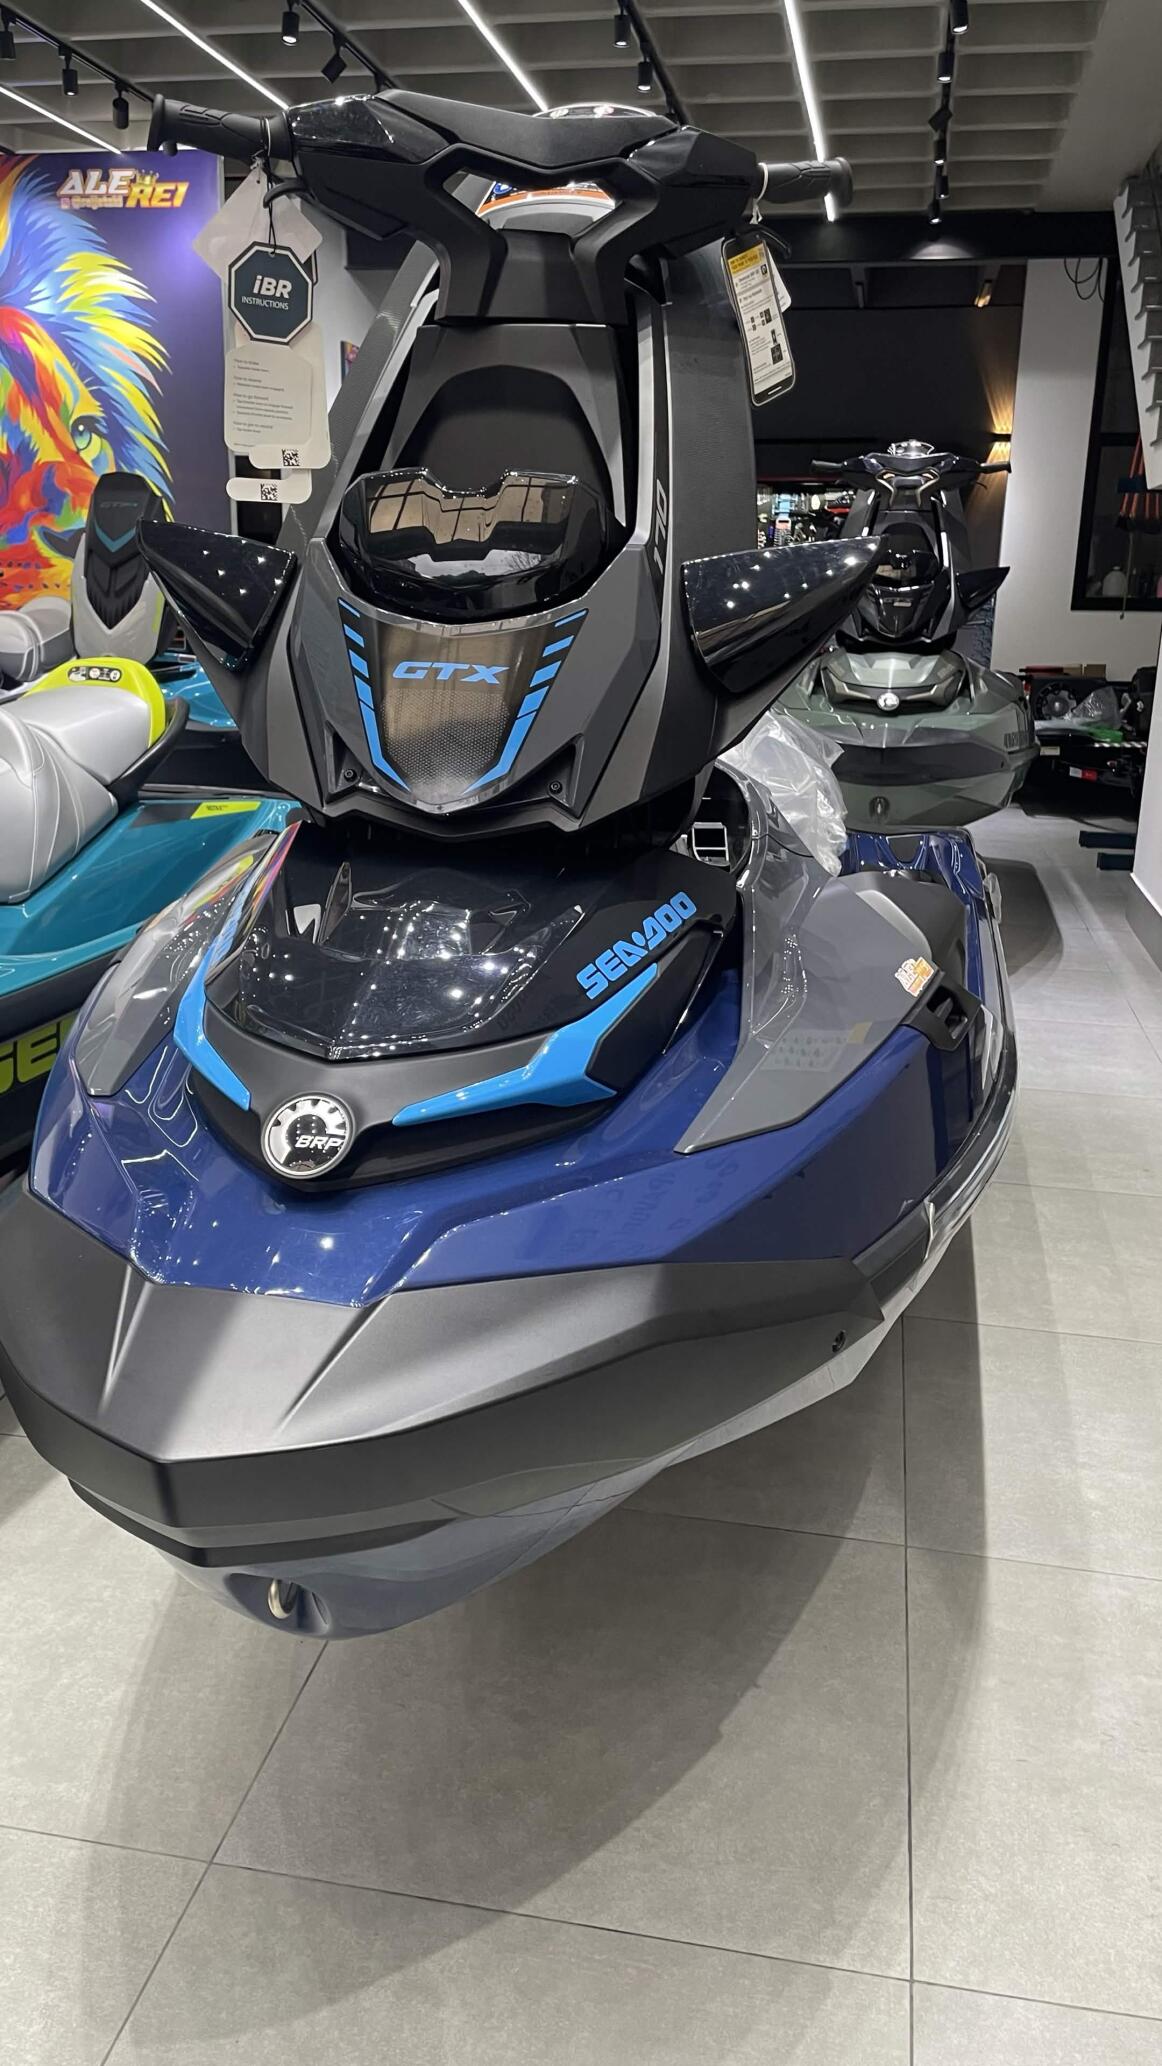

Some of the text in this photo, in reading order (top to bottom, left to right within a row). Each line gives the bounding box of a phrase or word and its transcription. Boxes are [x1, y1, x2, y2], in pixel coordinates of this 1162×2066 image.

[59, 169, 136, 196] ALE
[125, 182, 189, 208] REI
[253, 275, 292, 299] iBR
[241, 296, 289, 310] INSTRUCTIONS
[653, 478, 668, 575] 170
[392, 661, 510, 684] GTX
[295, 1134, 345, 1151] BRP
